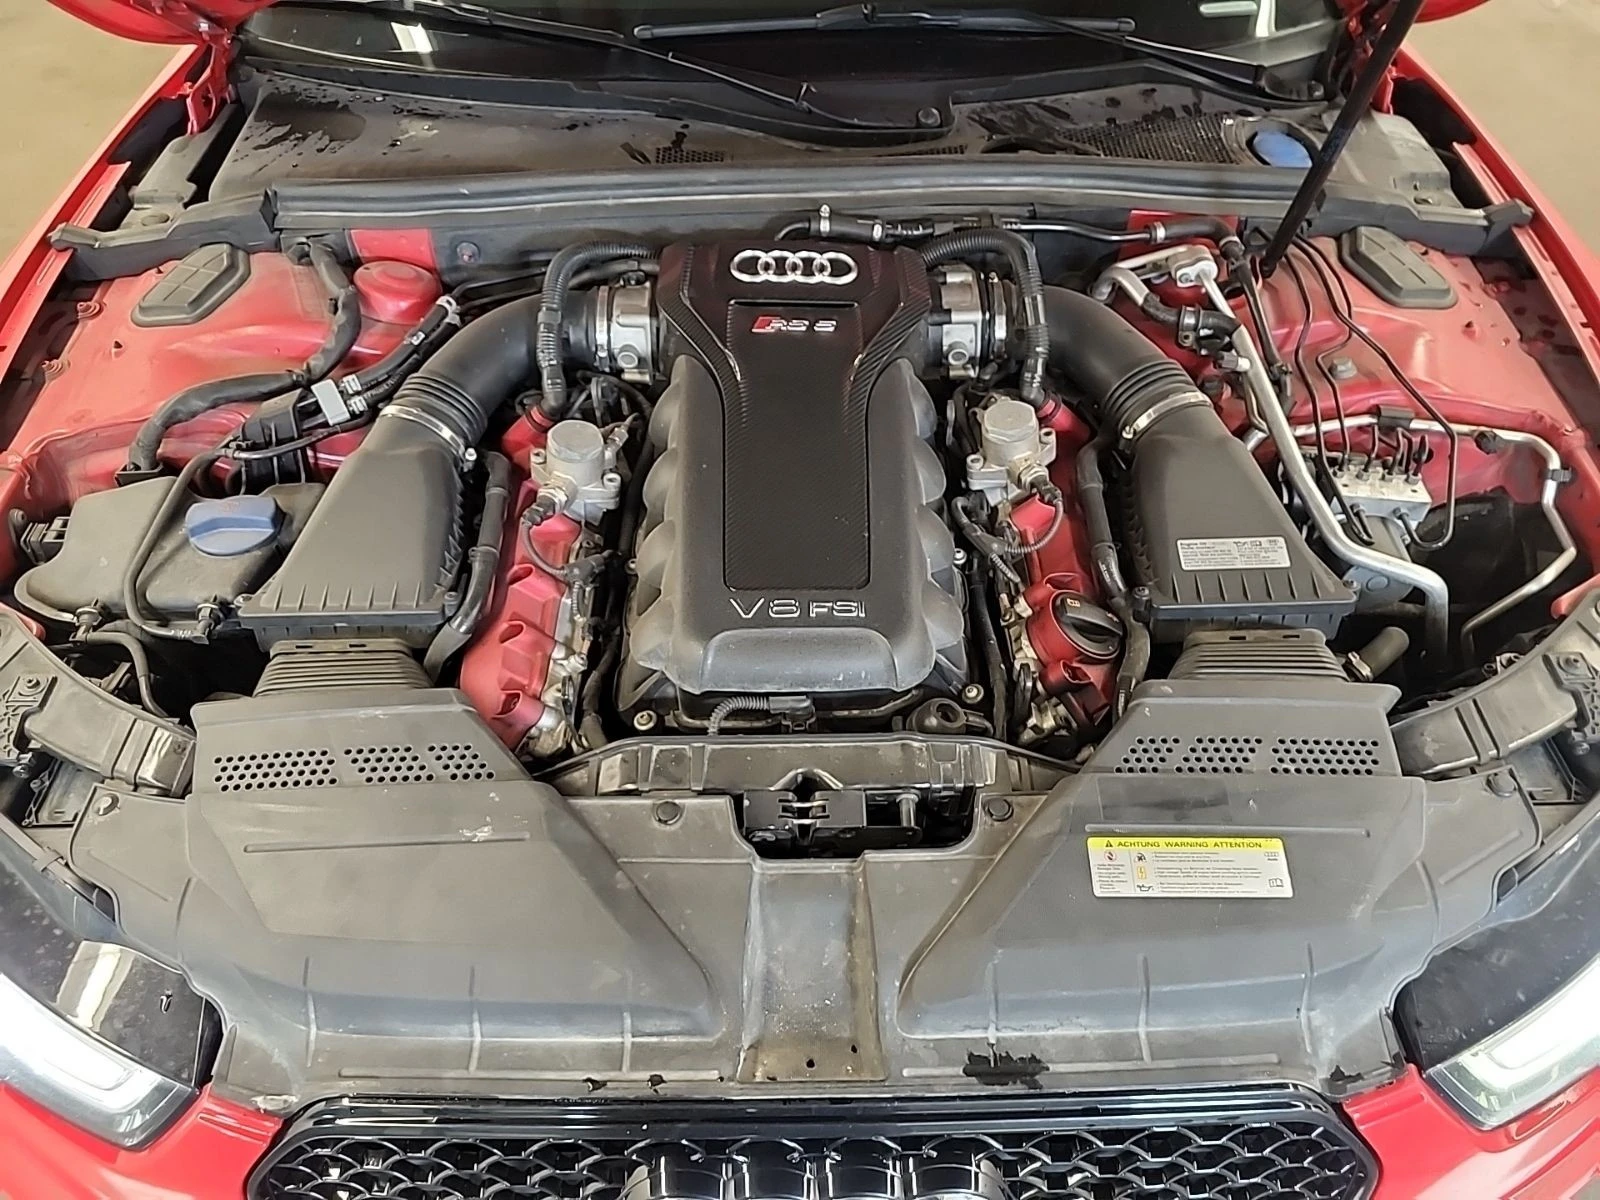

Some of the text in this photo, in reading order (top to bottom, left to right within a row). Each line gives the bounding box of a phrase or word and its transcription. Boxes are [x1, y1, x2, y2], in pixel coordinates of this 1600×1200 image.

[729, 597, 866, 618] V8 FSI
[1213, 841, 1262, 849] ATTENTION
